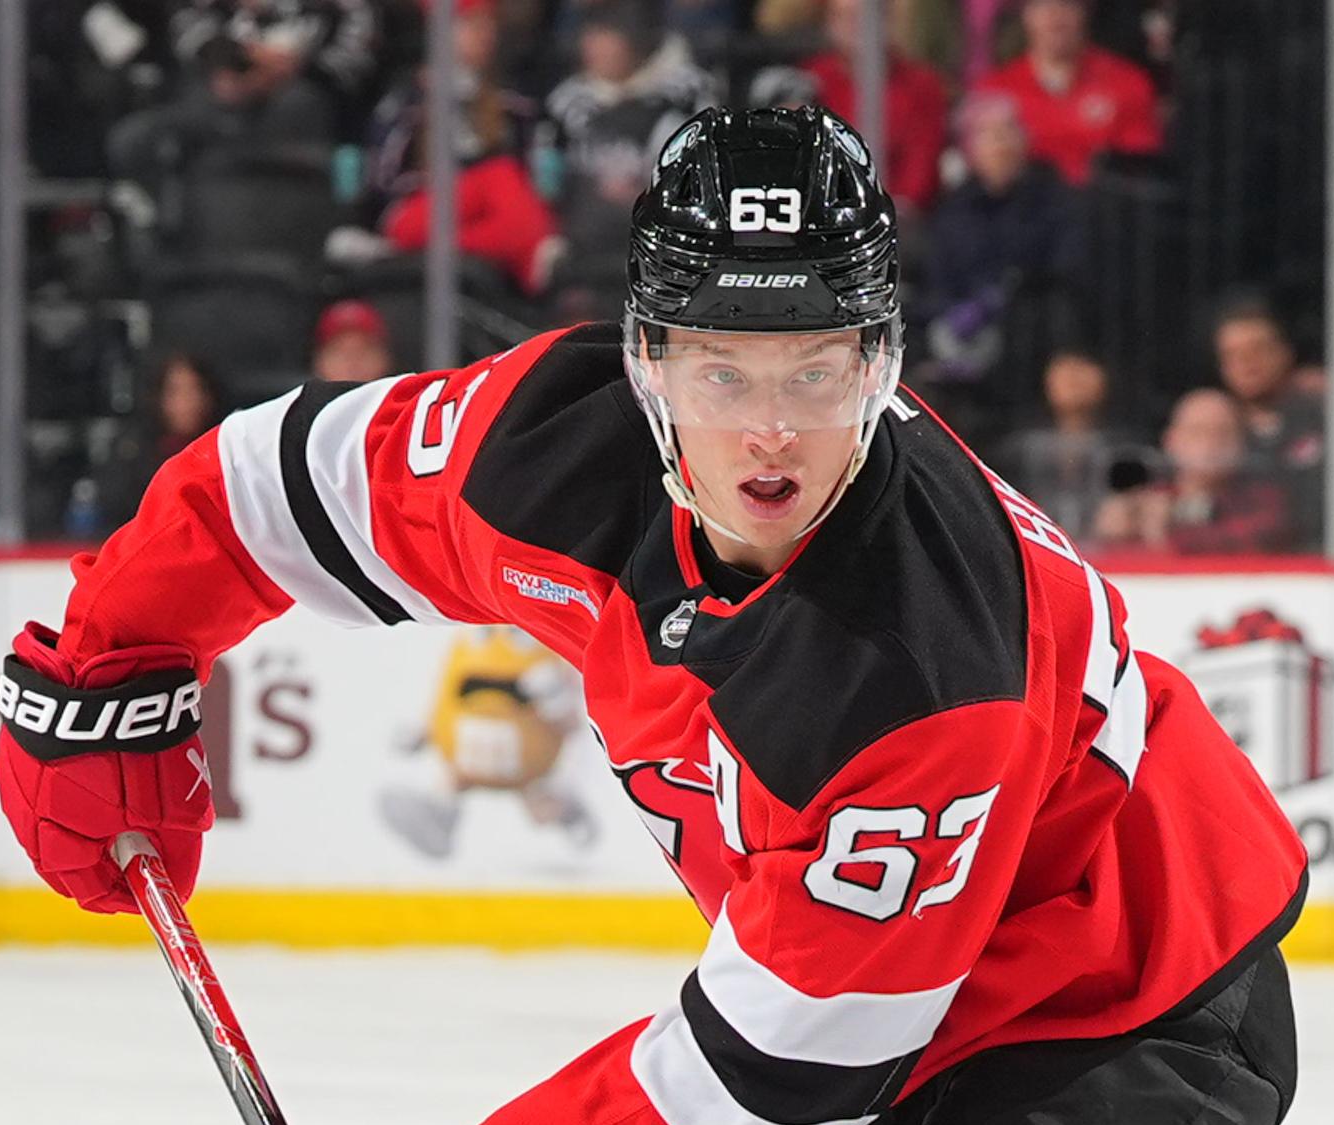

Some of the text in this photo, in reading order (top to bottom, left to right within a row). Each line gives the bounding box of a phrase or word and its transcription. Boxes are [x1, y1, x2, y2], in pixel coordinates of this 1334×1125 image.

[730, 188, 802, 234] 63
[717, 273, 809, 288] BAUER
[803, 783, 1002, 924] 63
